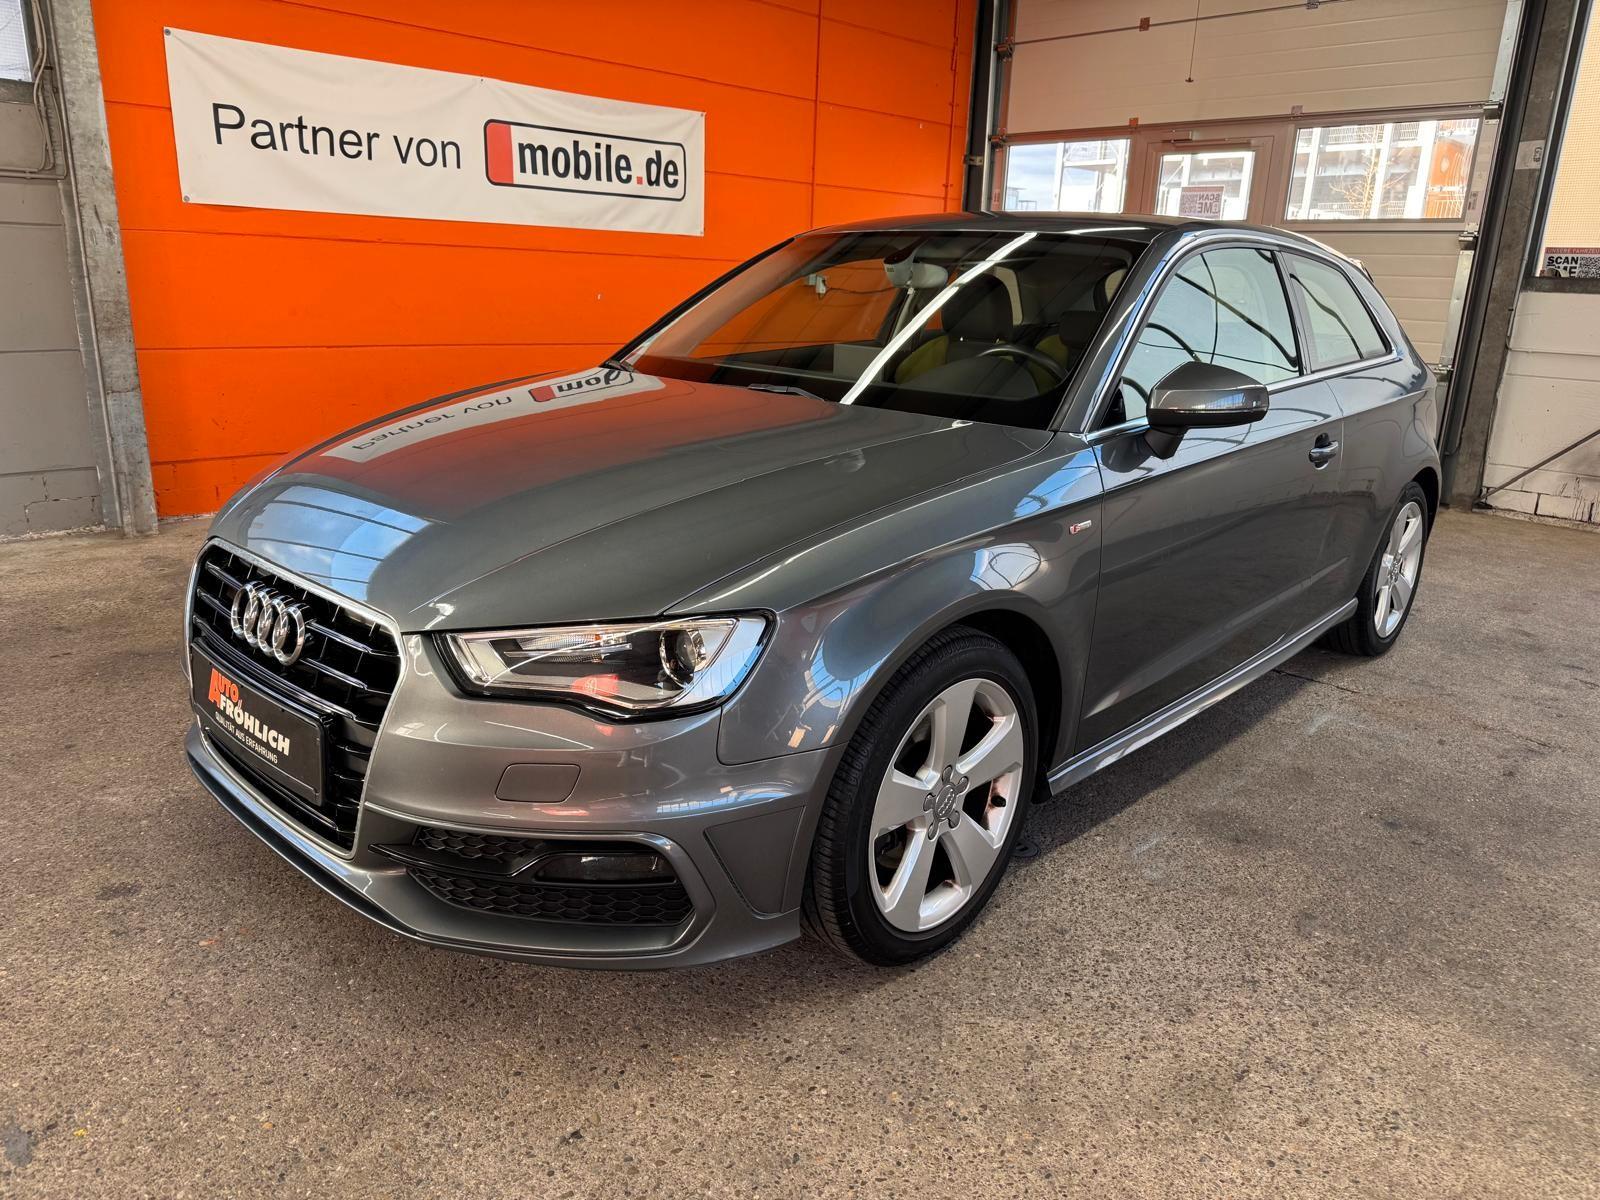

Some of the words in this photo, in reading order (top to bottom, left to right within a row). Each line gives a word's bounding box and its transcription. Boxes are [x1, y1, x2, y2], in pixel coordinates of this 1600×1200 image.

[211, 102, 380, 161] Partner
[392, 134, 461, 169] von
[517, 138, 680, 189] mobile.de
[1547, 256, 1579, 265] SCAN
[208, 667, 239, 708] AUTO
[220, 694, 290, 756] FRÖHLICH
[235, 729, 246, 742] AUS
[245, 735, 278, 764] ERFAHRUNG
